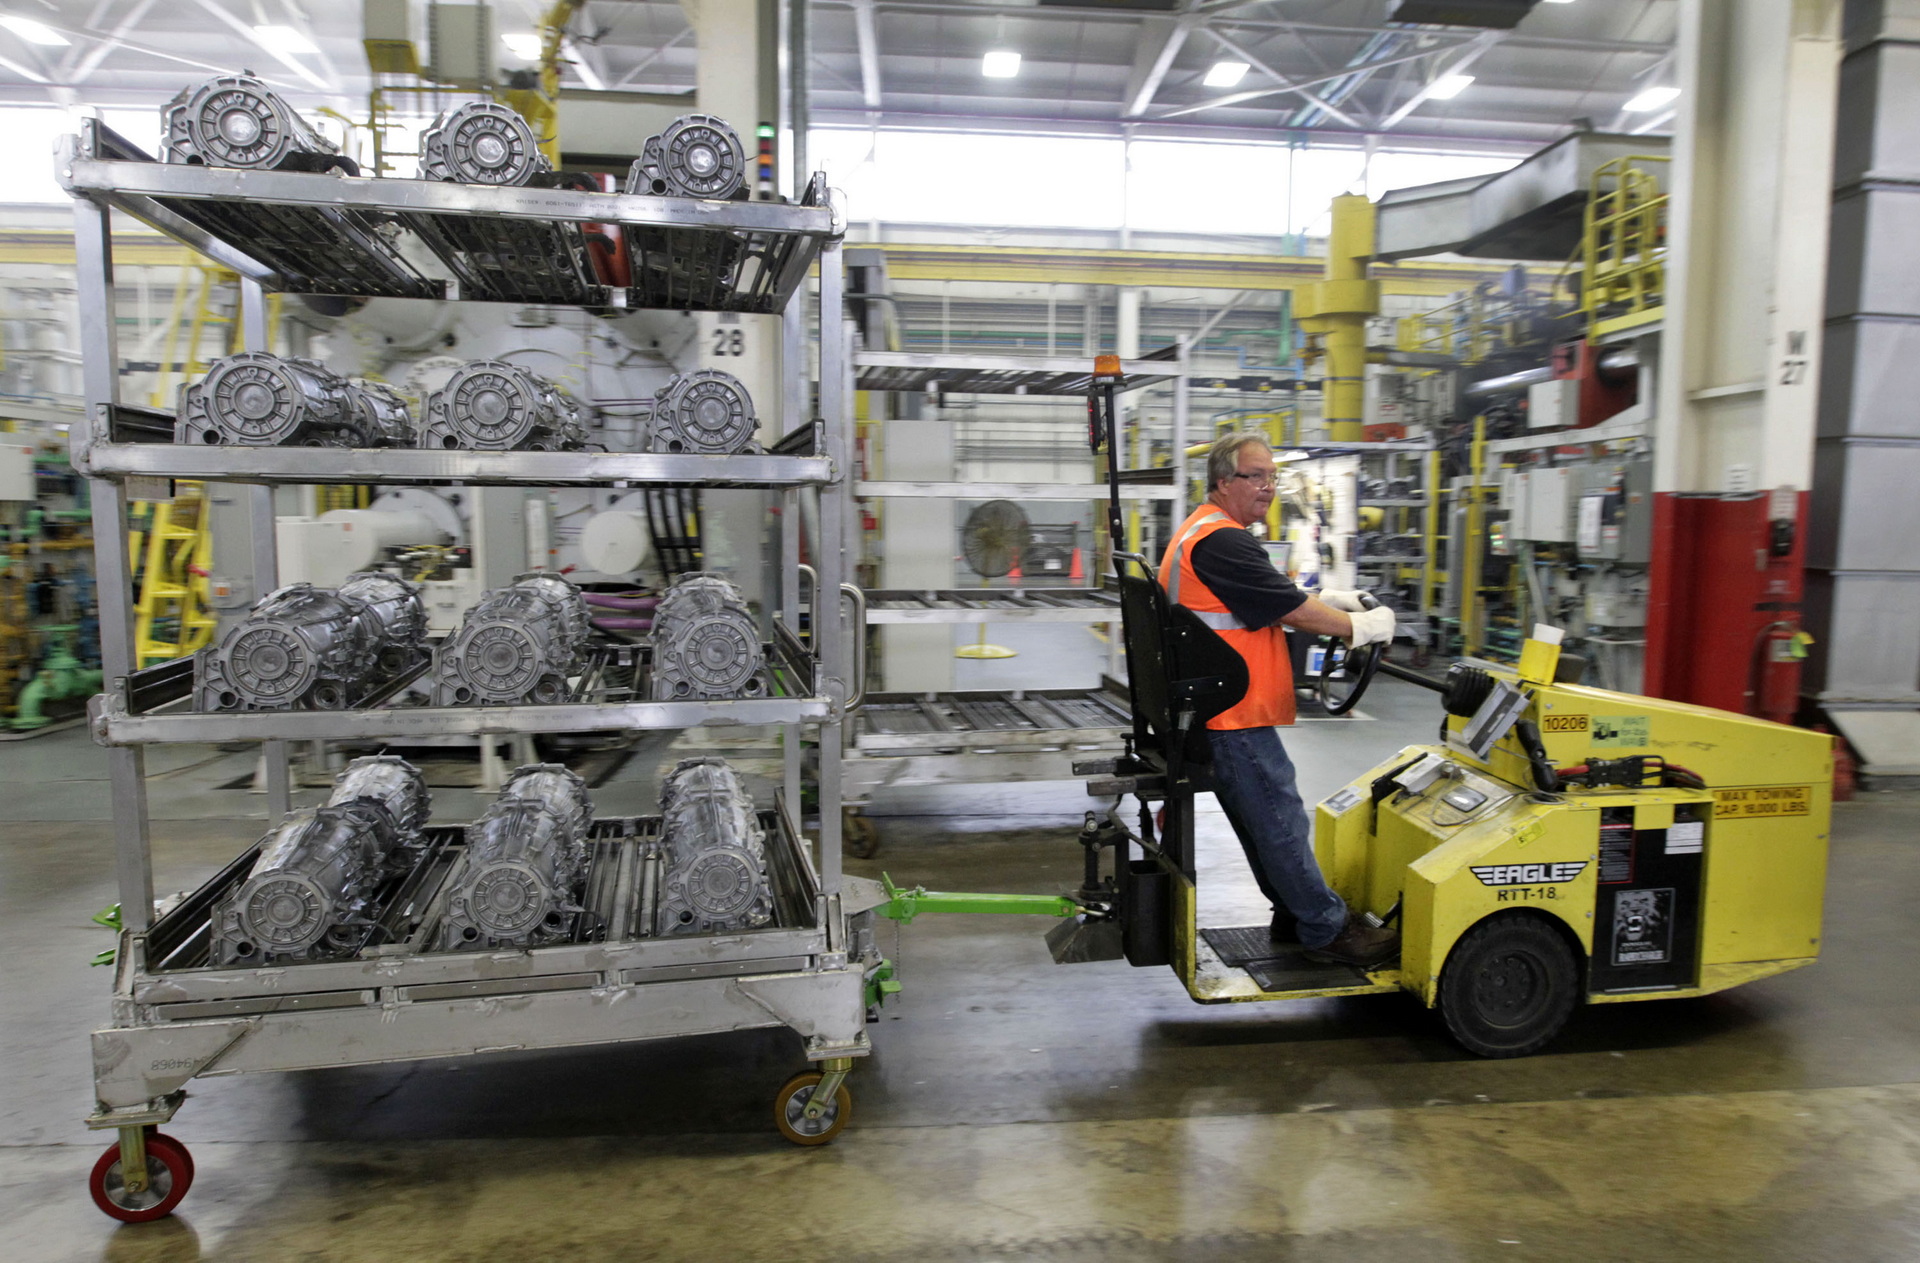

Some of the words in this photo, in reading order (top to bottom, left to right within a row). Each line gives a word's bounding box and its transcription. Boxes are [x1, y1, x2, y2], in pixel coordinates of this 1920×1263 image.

[711, 328, 746, 357] 28
[1778, 360, 1808, 386] 27
[1544, 717, 1587, 730] 10206
[1721, 790, 1748, 801] MAX
[1754, 788, 1803, 800] TOWING
[1493, 862, 1564, 884] EAGLE
[1497, 887, 1556, 901] RTT-18
